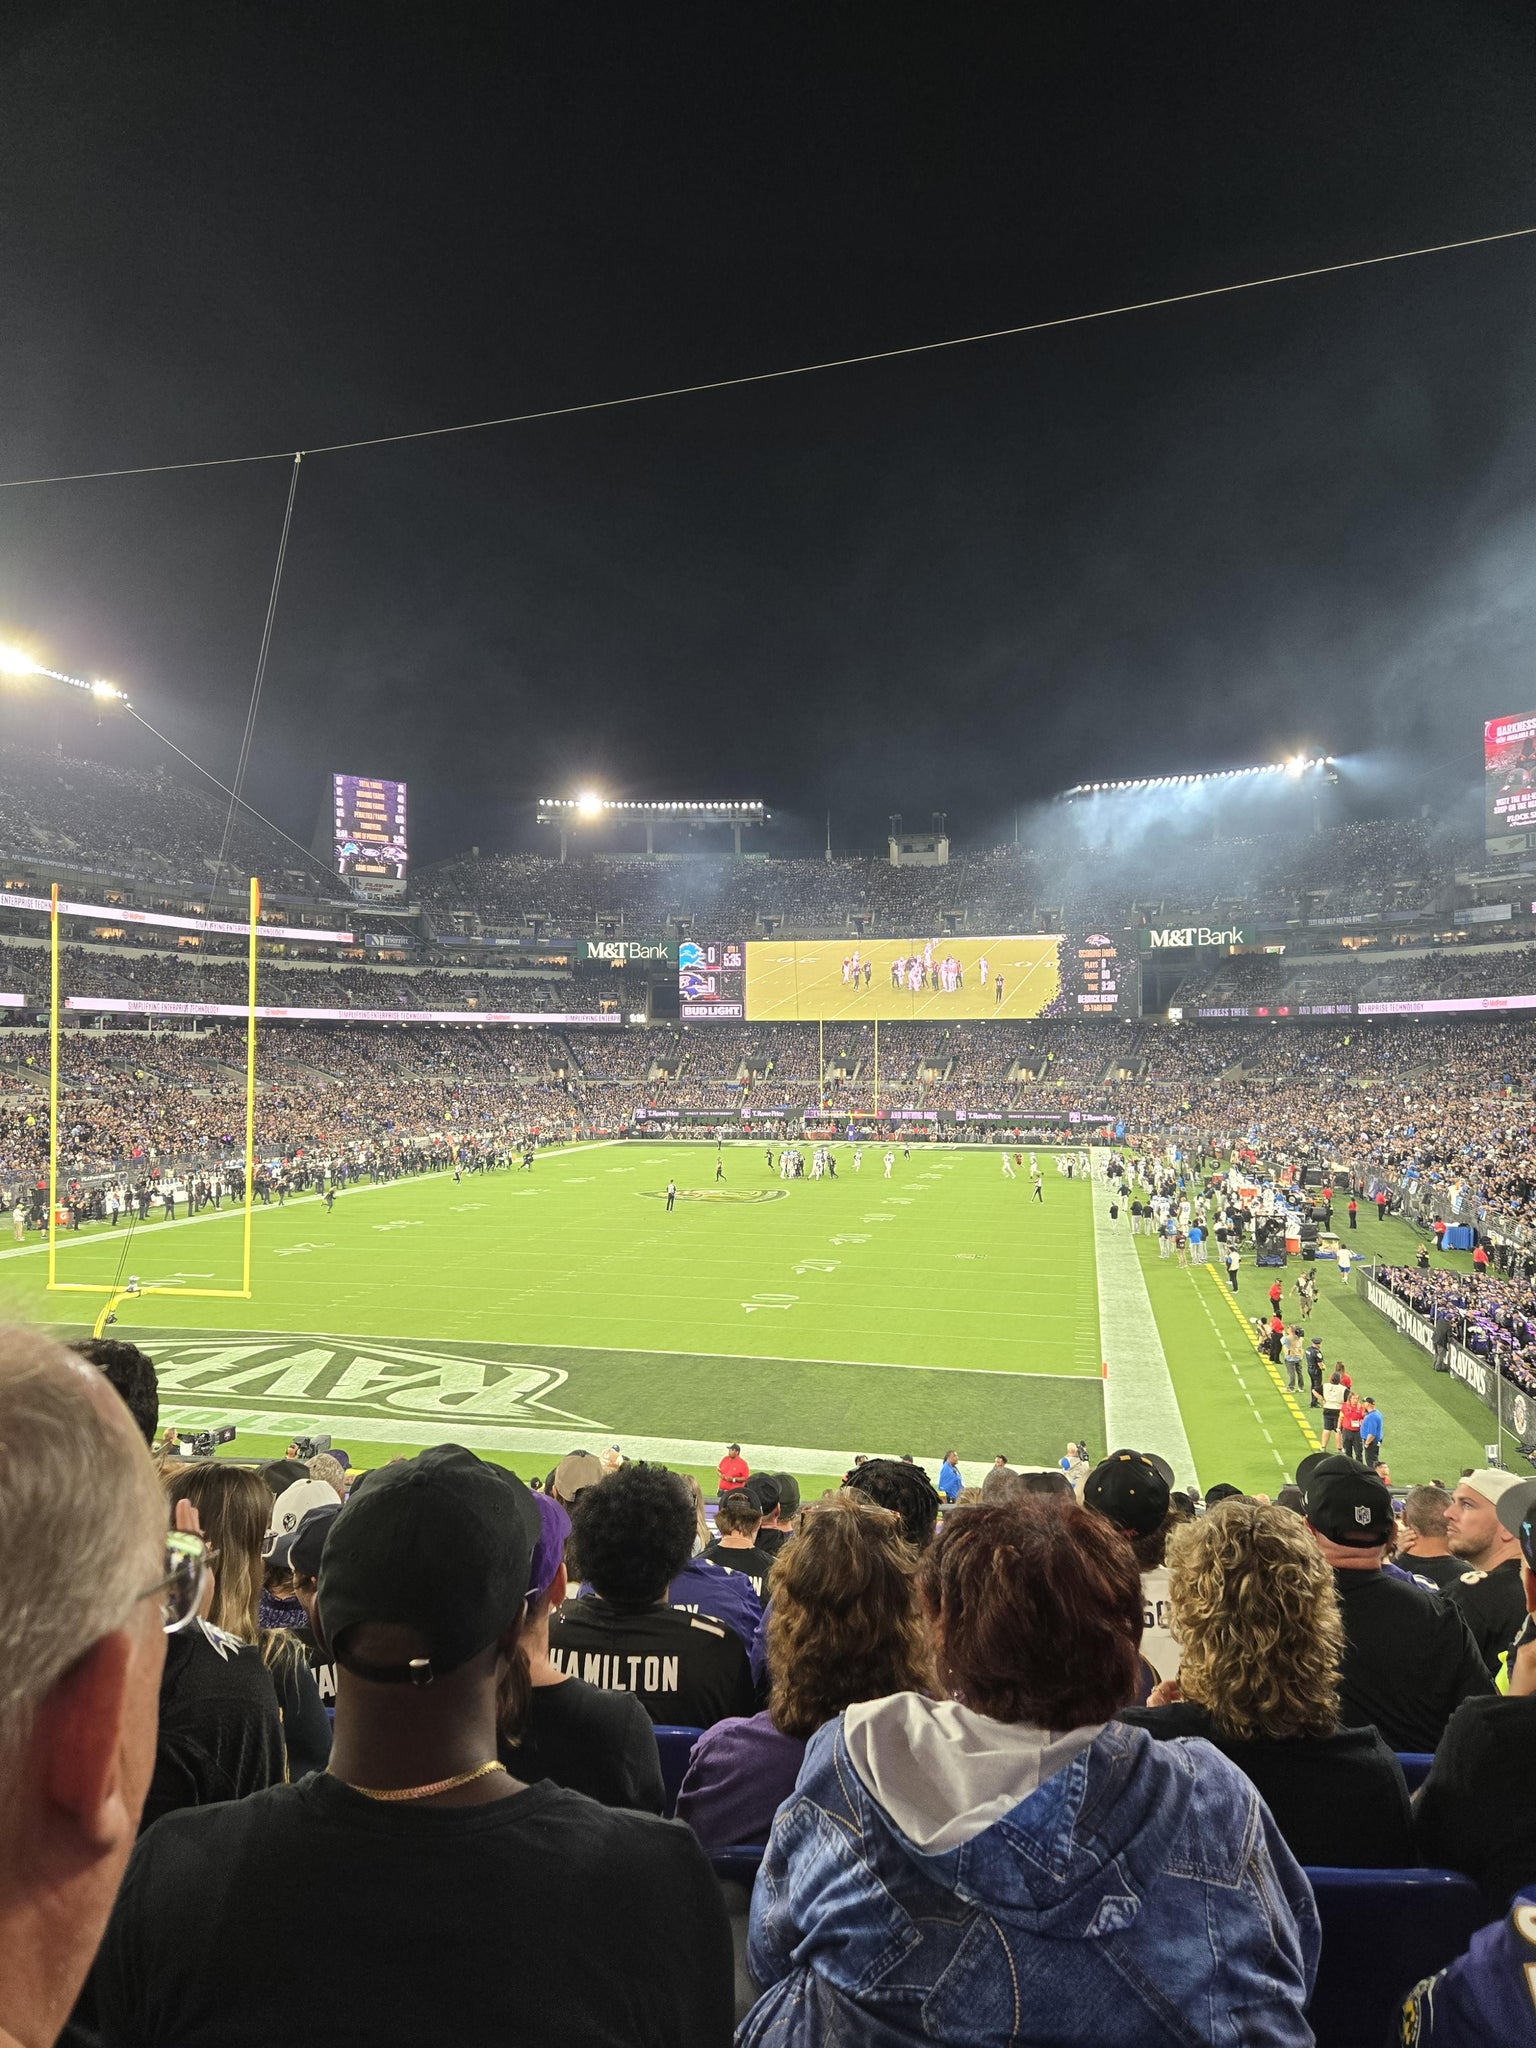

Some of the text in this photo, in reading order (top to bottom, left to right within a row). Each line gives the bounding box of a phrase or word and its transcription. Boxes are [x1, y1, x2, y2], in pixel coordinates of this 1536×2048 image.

[1496, 718, 1536, 738] DARKNESS
[1, 894, 69, 913] ENTERPRISE TECHNOGY
[196, 920, 226, 931] SIMPLIFYING
[385, 936, 409, 945] merritt
[1150, 925, 1244, 948] M&T Bank
[587, 942, 668, 959] M&T Bank
[707, 947, 715, 963] 0
[723, 954, 741, 967] 5:35
[128, 1003, 219, 1014] SIMPLIFYING ENTERPRISE TECHNOLOGY
[684, 1005, 740, 1016] BUD LIGHT
[1198, 1007, 1249, 1017] DARKNESS THERE
[1298, 1004, 1352, 1015] AND NOTHING MORE
[1389, 1002, 1424, 1012] TECHNOLOGY
[338, 1011, 432, 1020] SIMPLIFYING ENTERPRISE TECHNOLOGY
[565, 1014, 598, 1022] SIMPLIFYING
[741, 1293, 800, 1313] 10
[1367, 1280, 1406, 1327] BALTIMORE'S
[1450, 1343, 1487, 1396] RAVENS
[550, 1648, 679, 1692] HAMILTON
